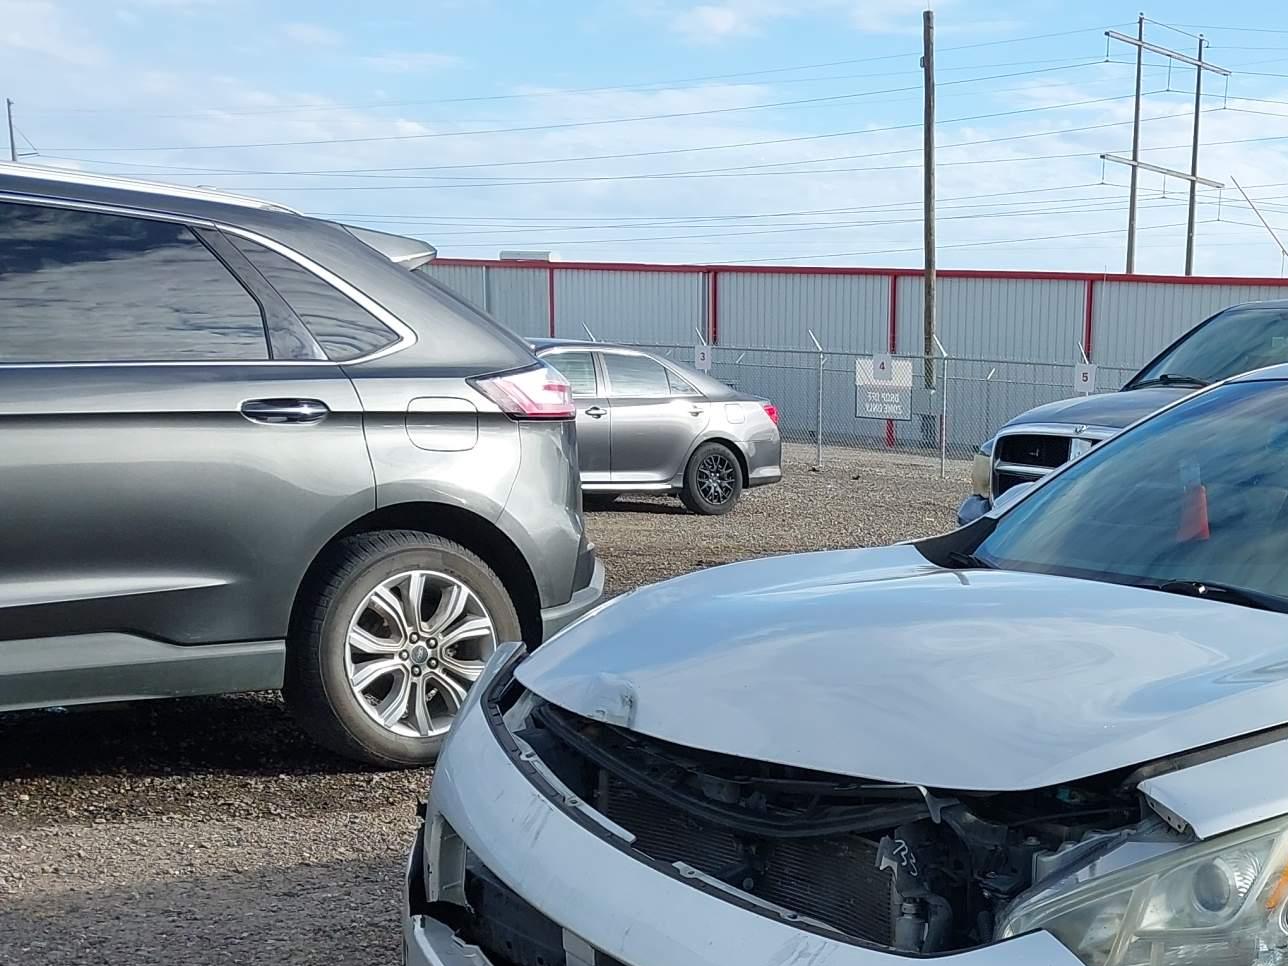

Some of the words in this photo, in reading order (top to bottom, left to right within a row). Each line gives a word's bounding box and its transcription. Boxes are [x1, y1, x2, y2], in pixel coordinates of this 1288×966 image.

[699, 352, 706, 361] 3
[879, 362, 885, 370] 4
[1082, 372, 1089, 383] 5
